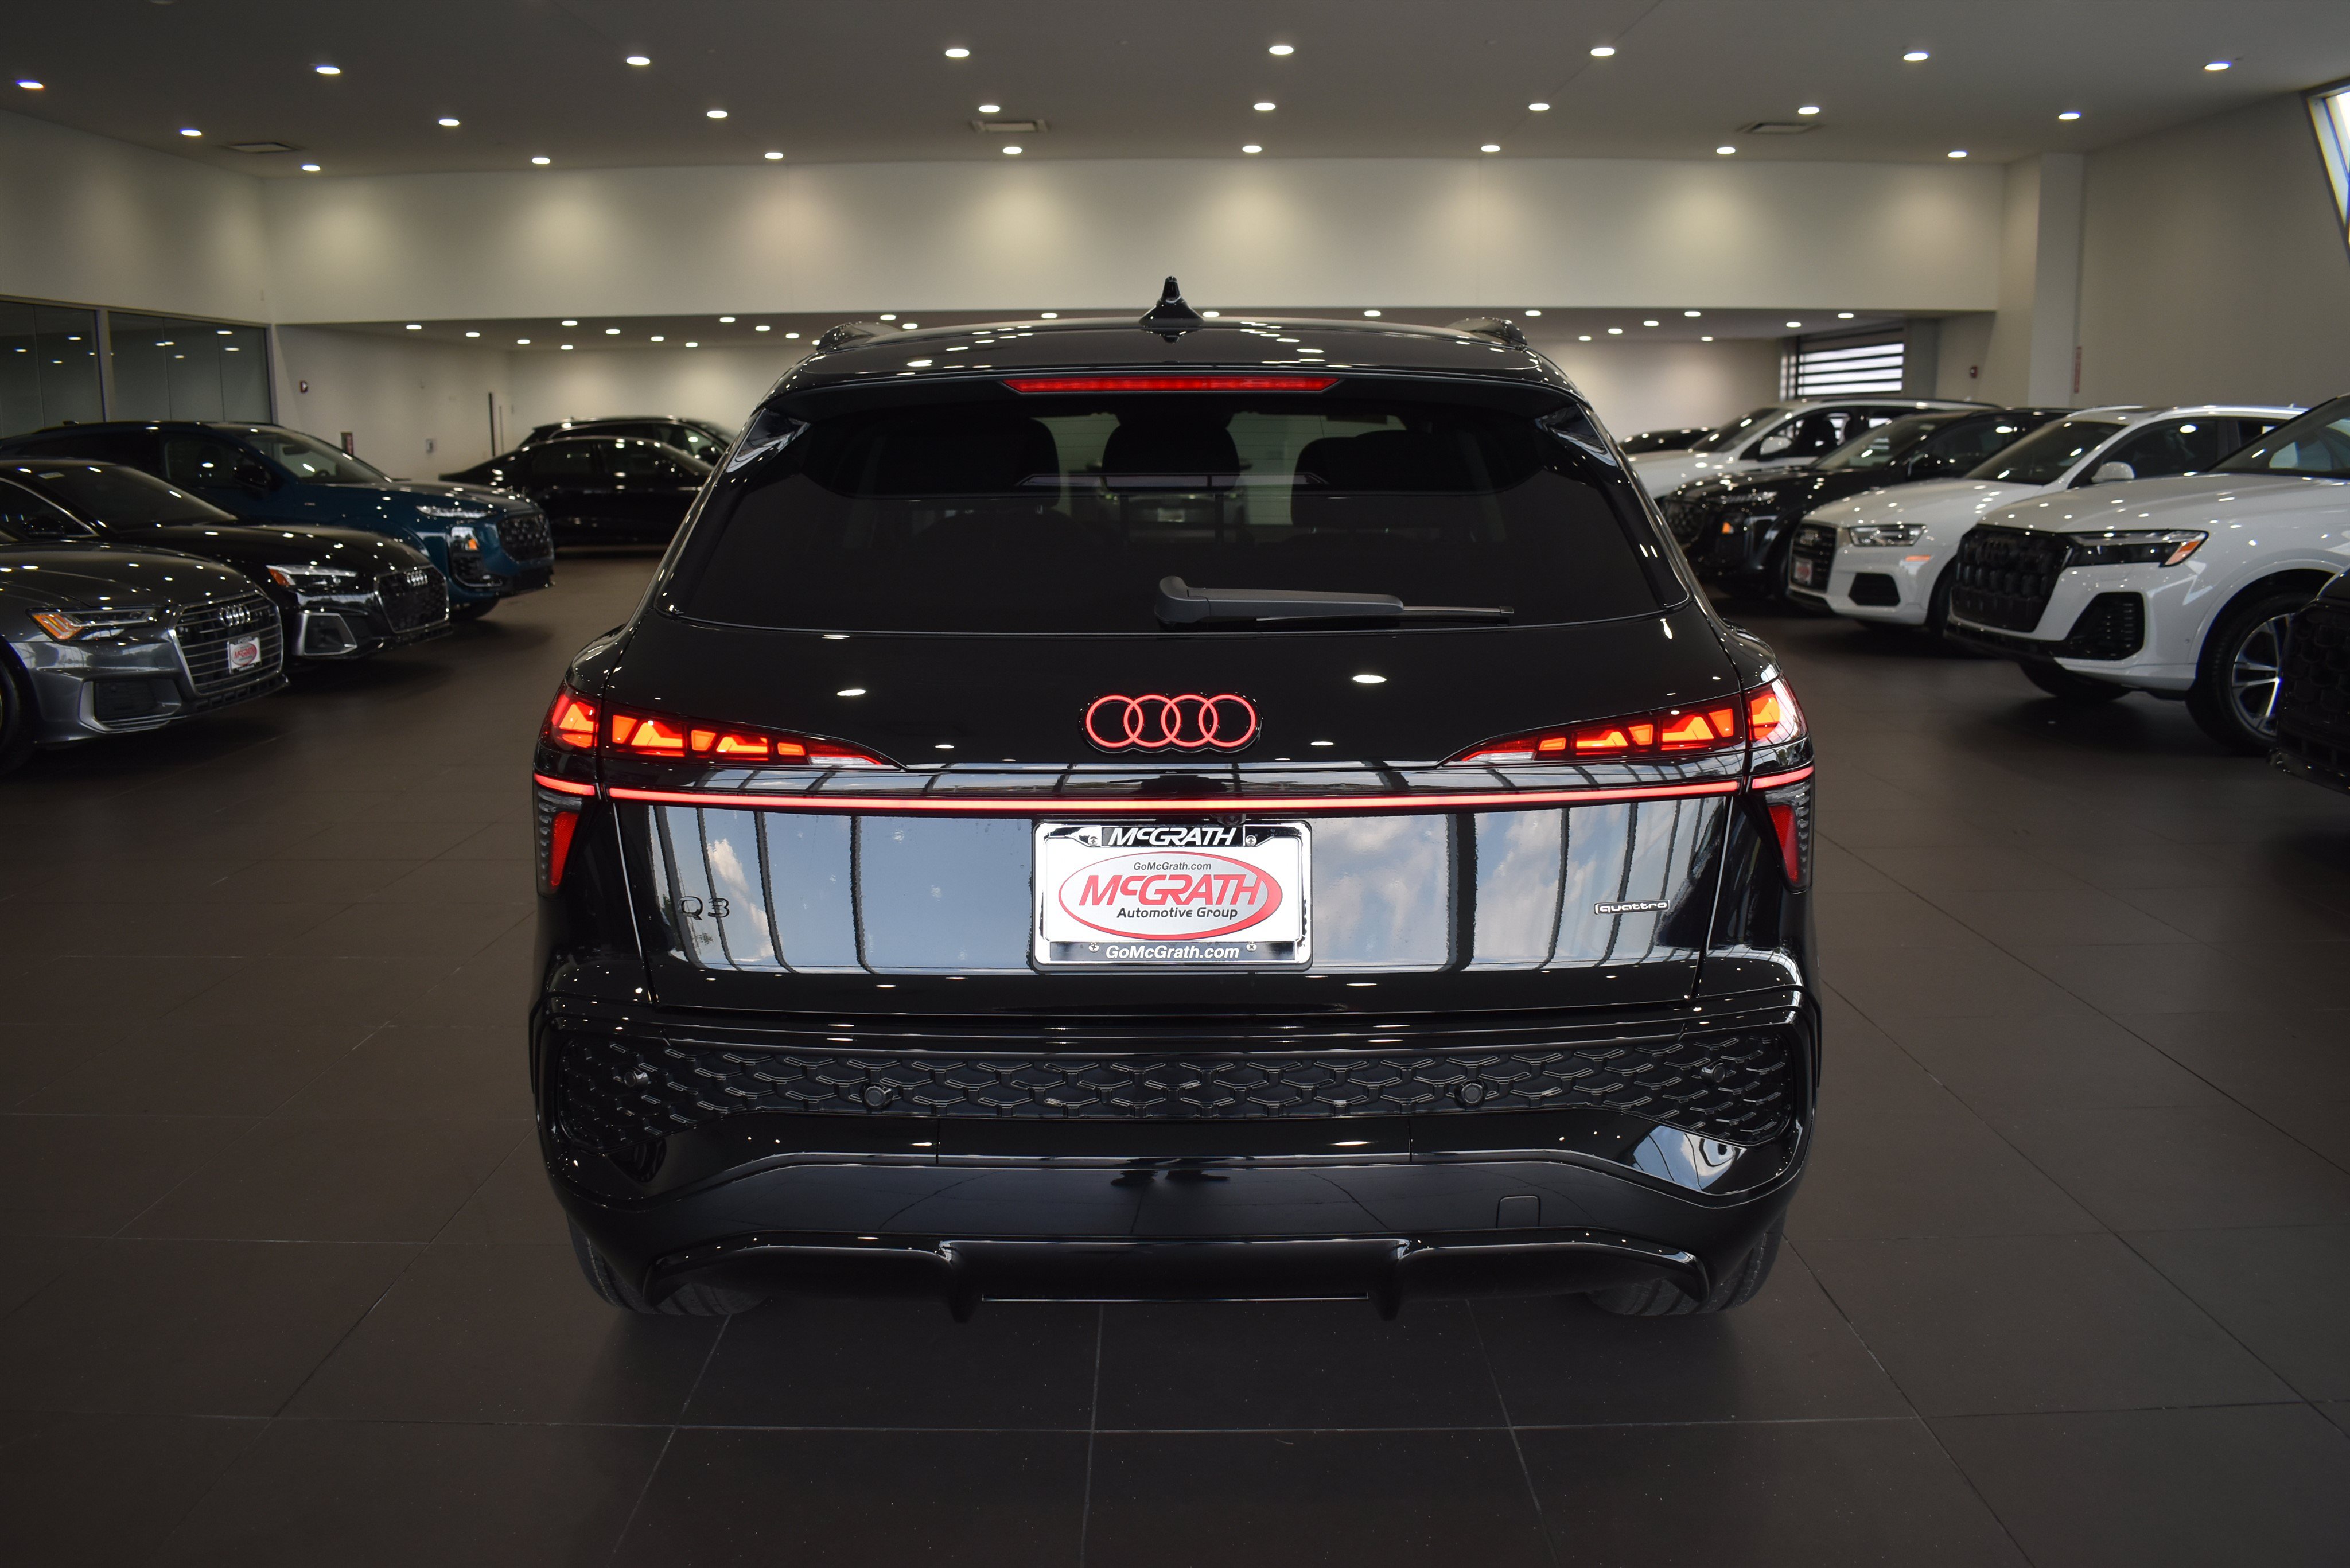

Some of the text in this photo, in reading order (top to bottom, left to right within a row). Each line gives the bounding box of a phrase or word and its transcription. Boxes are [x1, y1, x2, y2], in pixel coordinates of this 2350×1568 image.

[1133, 862, 1212, 871] GoMcGrath.com
[678, 896, 730, 920] Q3
[1600, 902, 1667, 913] quattro
[1116, 908, 1238, 920] Automotive Group
[1106, 945, 1239, 959] GoMcGrath.com
